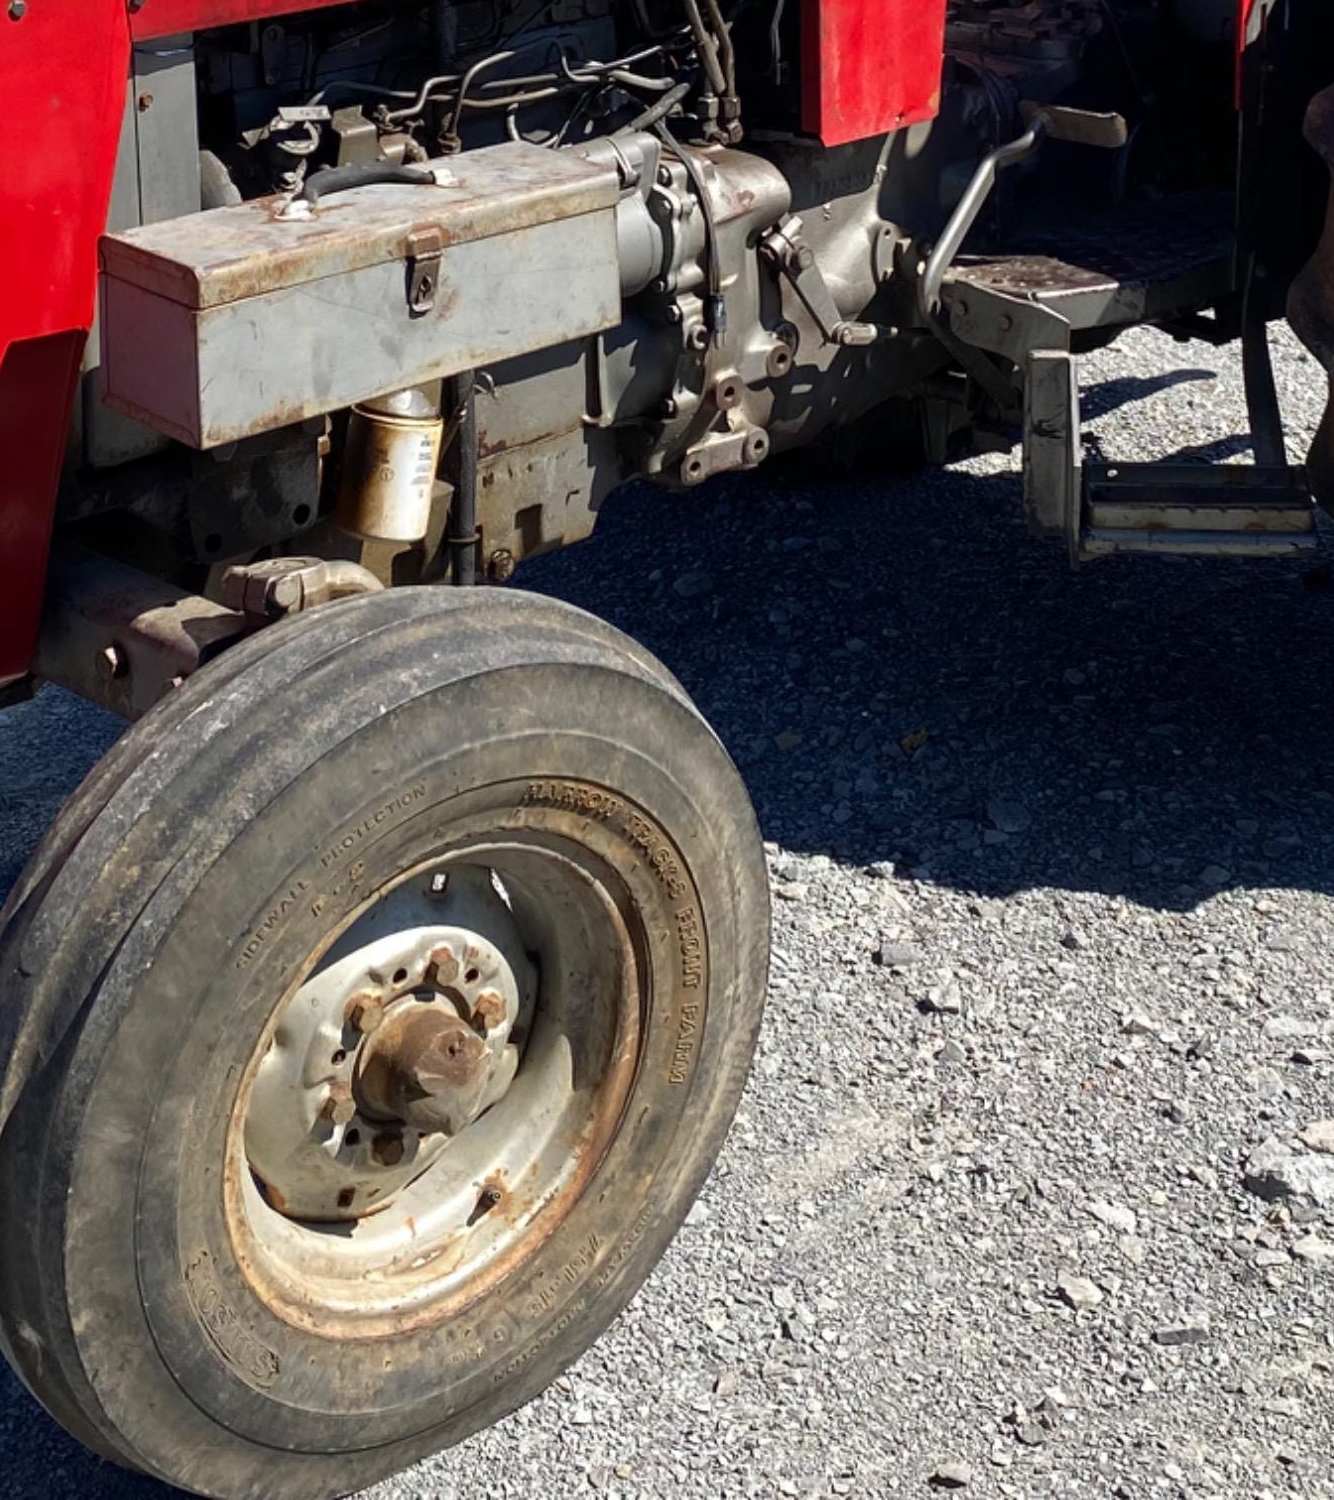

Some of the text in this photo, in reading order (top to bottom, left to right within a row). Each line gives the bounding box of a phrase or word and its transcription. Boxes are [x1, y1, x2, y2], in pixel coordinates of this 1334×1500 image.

[235, 879, 312, 971] SIDEWALL
[320, 783, 427, 868] PROTECTION
[675, 906, 701, 989] FRONT
[669, 1003, 699, 1084] FARM
